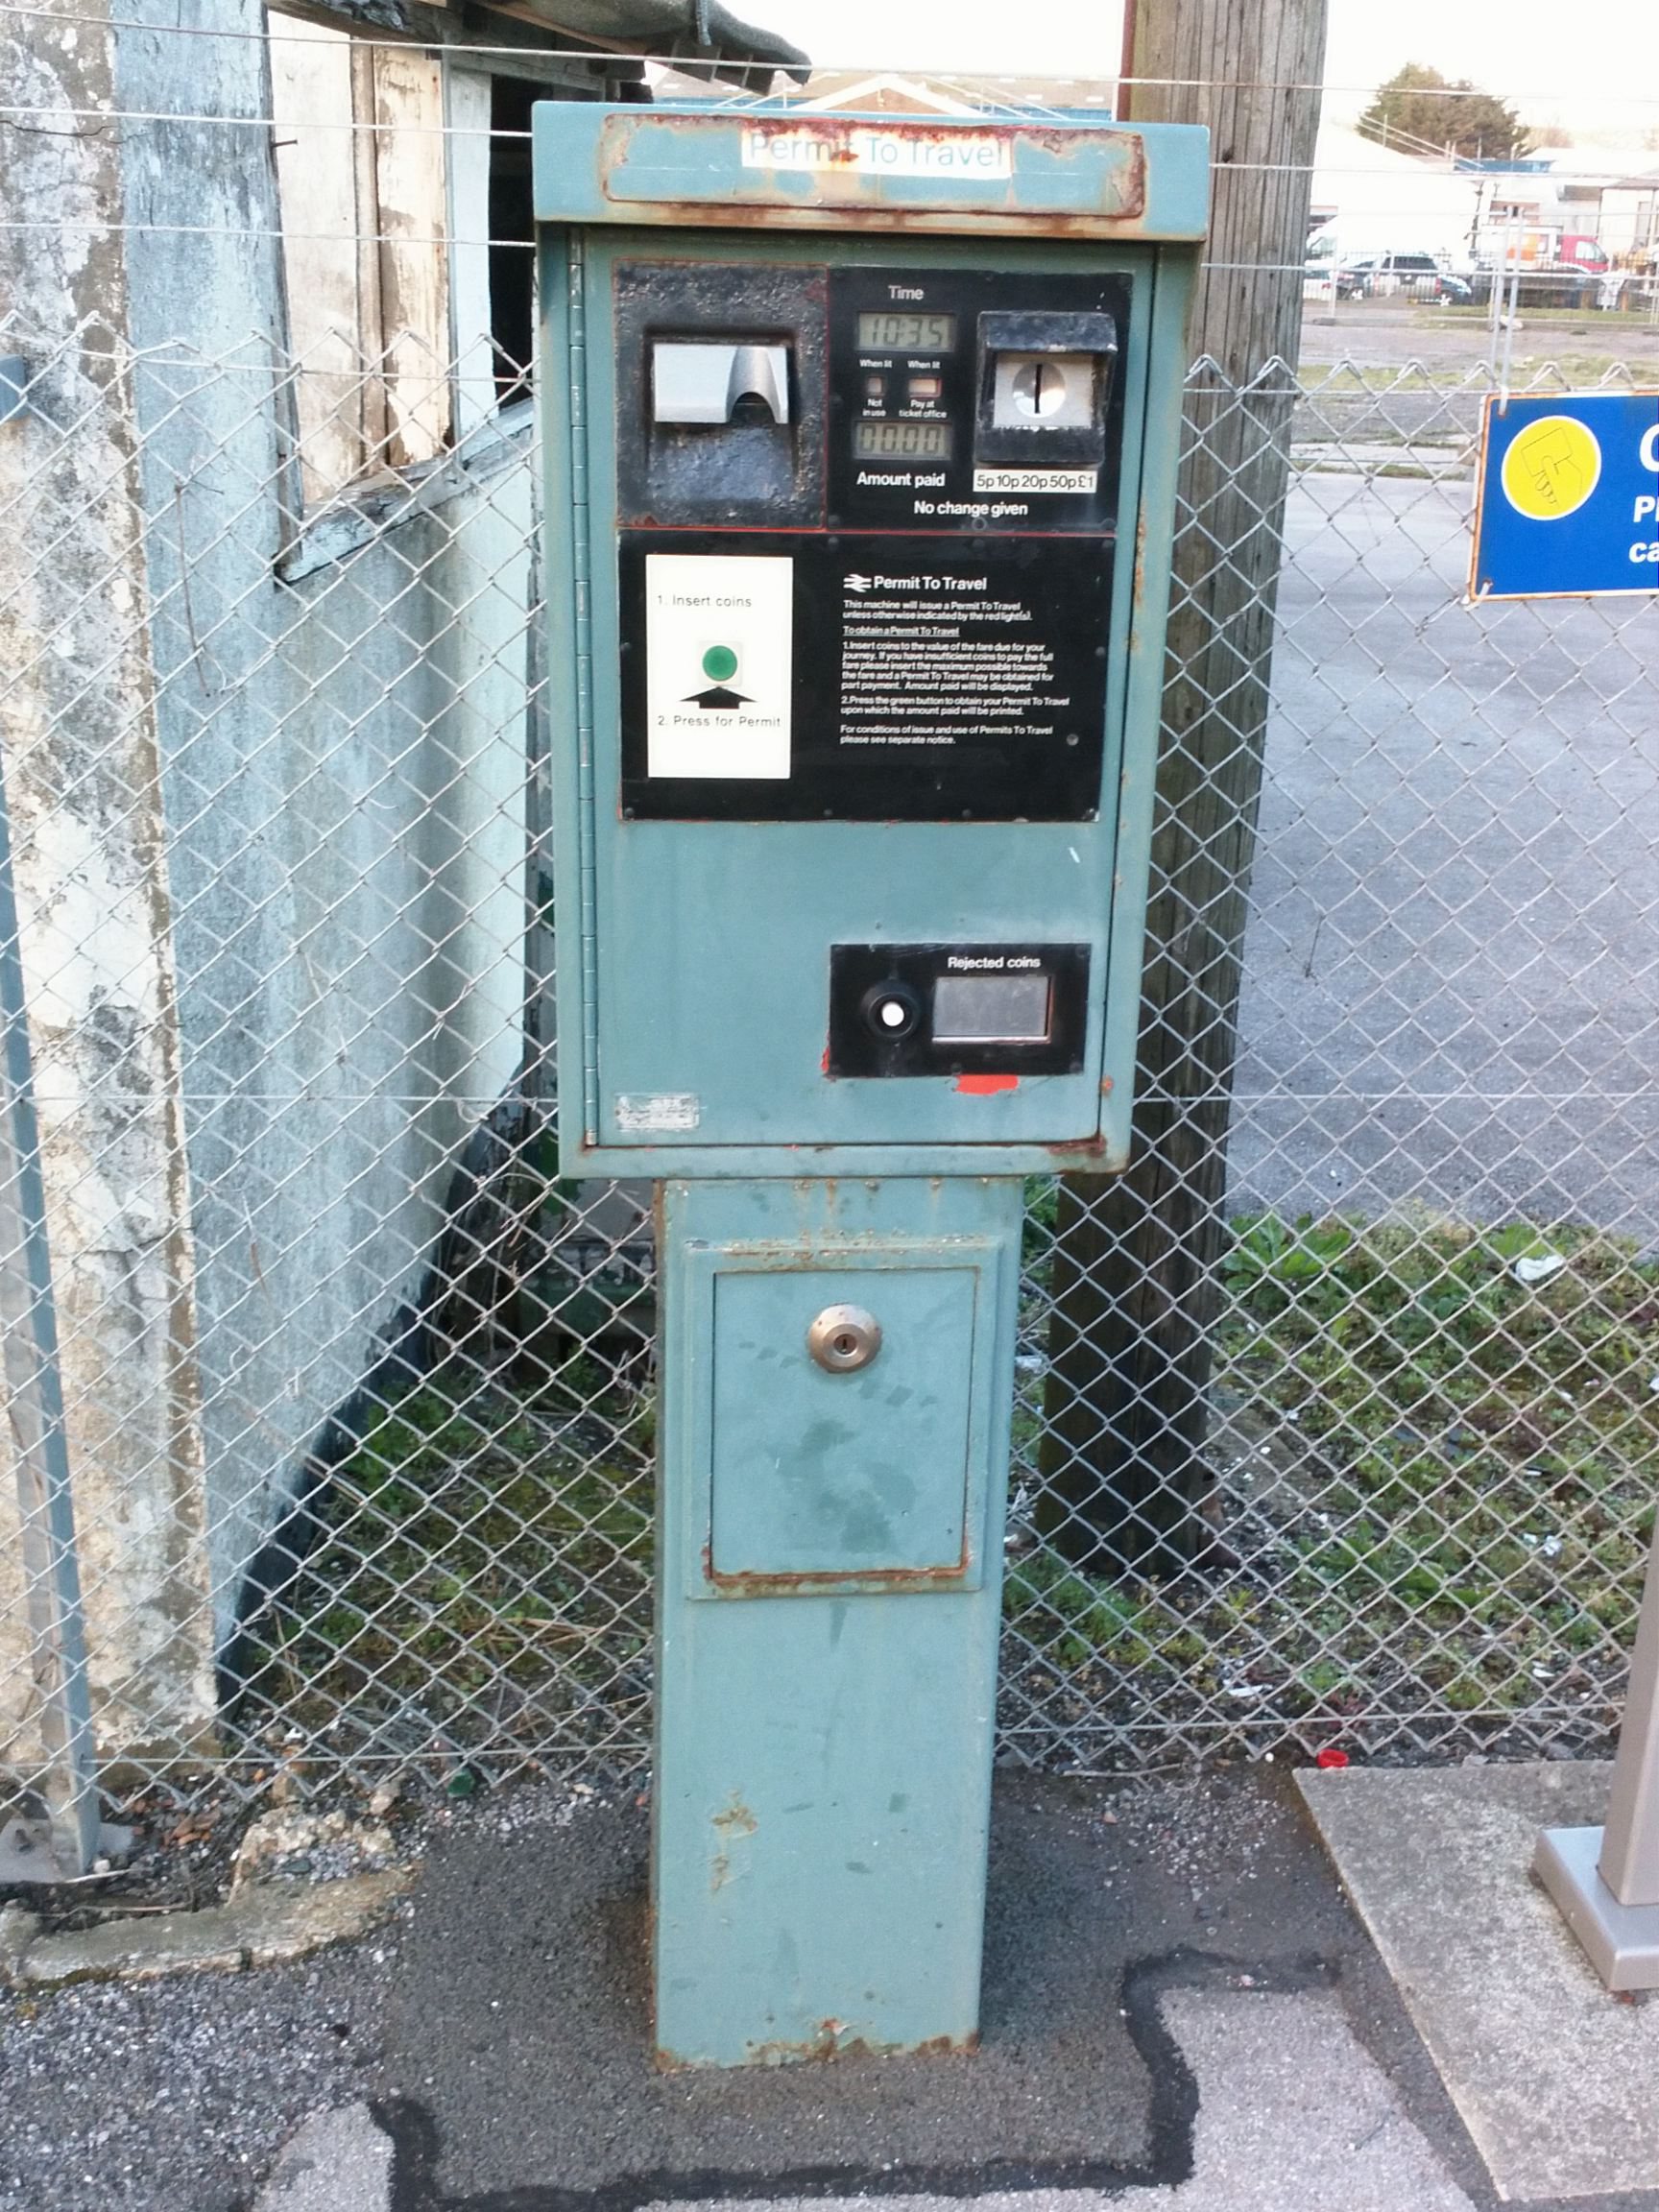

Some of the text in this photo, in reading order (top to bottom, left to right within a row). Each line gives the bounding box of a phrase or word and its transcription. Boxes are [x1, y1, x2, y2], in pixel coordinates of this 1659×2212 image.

[750, 132, 1002, 167] Permit To Travel
[888, 285, 925, 301] Time
[859, 359, 893, 369] When lit
[907, 360, 941, 370] When lit
[867, 398, 882, 407] Not
[910, 399, 926, 409] Pay
[862, 408, 871, 417] in
[899, 409, 948, 419] ticket office
[856, 471, 946, 489] Amount paid
[977, 474, 1094, 490] 5p 10p 20p 50p £1
[914, 501, 1028, 518] No change given
[874, 576, 987, 590] Permit To Travel
[673, 595, 710, 607] Insert
[715, 596, 753, 608] coins
[843, 600, 862, 609] This
[864, 600, 901, 610] machine
[902, 601, 918, 610] will
[919, 601, 942, 610] issue
[950, 601, 980, 611] Permit
[981, 601, 993, 611] To
[993, 601, 1021, 611] Travel
[843, 611, 1033, 622] unless otherwise indicated by the red light(s).
[843, 626, 854, 635] To
[855, 626, 883, 635] obtain
[890, 627, 920, 636] Permit
[920, 627, 931, 636] To
[931, 627, 959, 636] Travel
[876, 641, 900, 650] coins
[911, 642, 926, 651] the
[926, 642, 950, 651] value
[950, 642, 960, 651] of
[961, 642, 975, 651] the
[976, 642, 994, 651] fare
[995, 642, 1011, 651] due
[1012, 642, 1025, 652] for
[1026, 644, 1046, 653] your
[843, 652, 877, 661] journey.
[878, 651, 885, 660] If
[903, 652, 924, 661] have
[925, 652, 973, 661] insufficient
[973, 652, 996, 661] coins
[1007, 654, 1023, 662] pay
[1024, 653, 1039, 661] the
[1040, 653, 1054, 661] full
[860, 661, 890, 670] please
[890, 661, 916, 670] insert
[932, 662, 974, 671] maximum
[975, 662, 1011, 672] possible
[1012, 662, 1048, 671] towards
[842, 671, 856, 680] the
[857, 671, 876, 680] fare
[876, 671, 894, 680] and
[901, 671, 929, 680] Permit
[944, 672, 970, 681] Travel
[841, 682, 860, 690] part
[861, 682, 902, 691] payment.
[904, 681, 939, 689] Amount
[940, 682, 960, 691] paid
[961, 682, 976, 690] will
[990, 682, 1033, 692] displayed.
[876, 696, 890, 705] the
[890, 697, 915, 706] green
[916, 696, 945, 705] button
[945, 696, 954, 705] to
[954, 697, 982, 706] obtain
[983, 698, 1001, 707] your
[1002, 696, 1031, 706] Permit
[1032, 697, 1044, 706] To
[1044, 697, 1070, 706] Travel
[864, 706, 891, 714] which
[891, 706, 905, 714] the
[906, 707, 939, 715] amount
[940, 707, 960, 716] paid
[961, 707, 977, 715] will
[977, 707, 989, 715] be
[989, 707, 1024, 716] printed.
[673, 716, 709, 727] Press
[715, 716, 733, 727] for
[739, 716, 781, 728] Permit
[840, 725, 855, 733] For
[856, 725, 901, 733] conditions
[902, 725, 911, 733] of
[912, 725, 935, 733] issue
[935, 725, 951, 734] and
[969, 726, 979, 734] of
[979, 725, 1013, 734] Permits
[1013, 726, 1025, 734] To
[1026, 726, 1053, 734] Travel
[840, 735, 870, 745] please
[887, 736, 926, 745] separate
[948, 955, 1042, 970] Rejected coins
